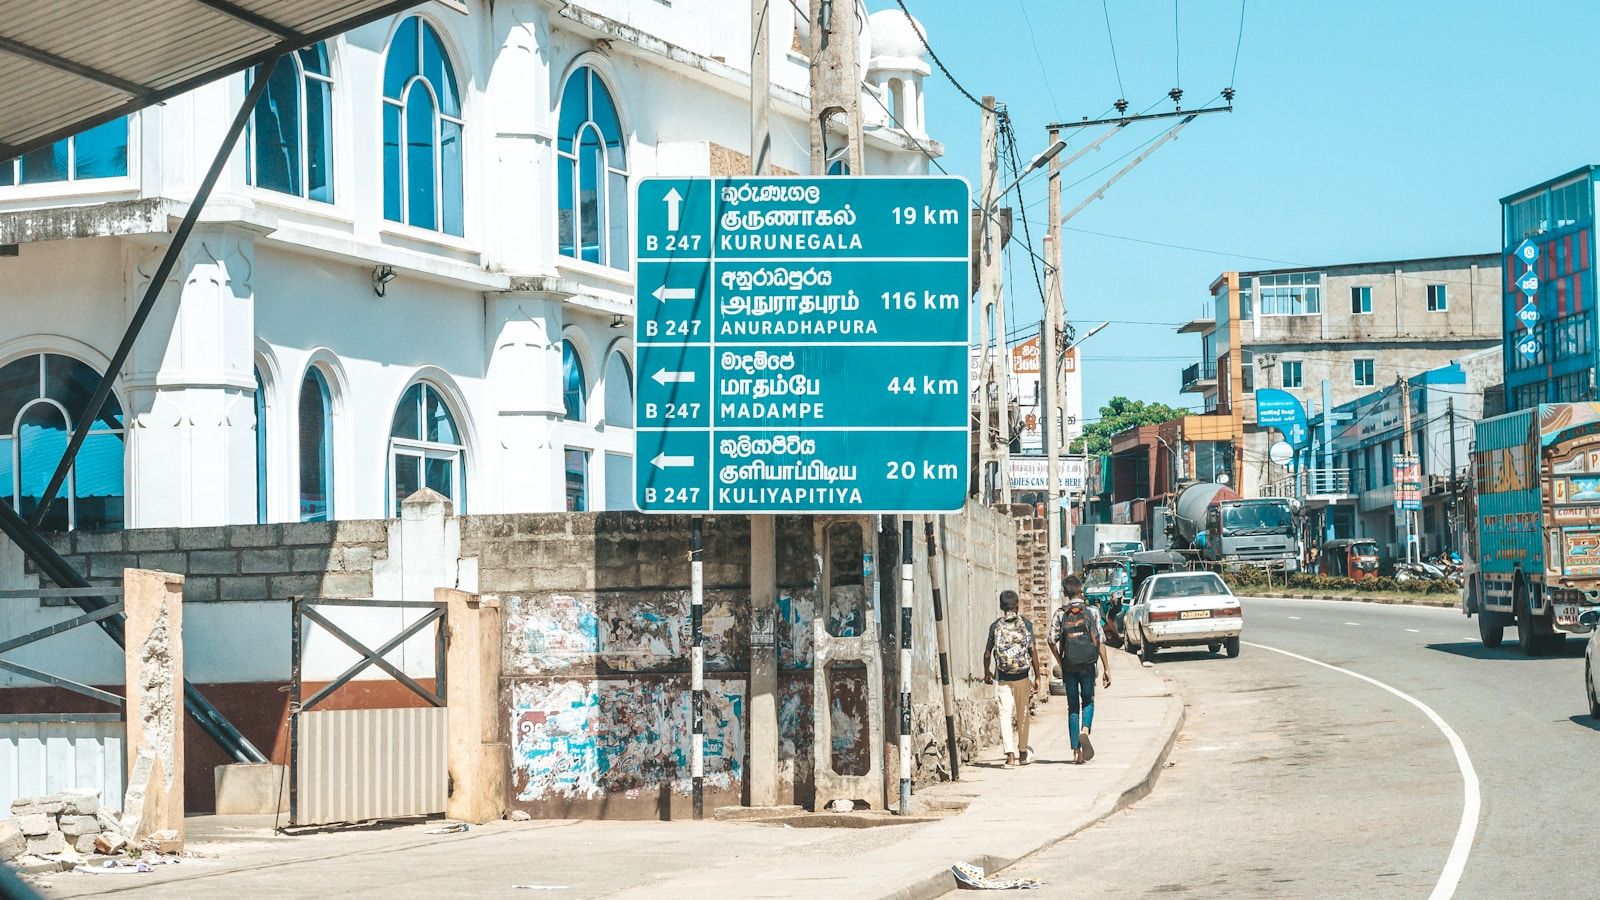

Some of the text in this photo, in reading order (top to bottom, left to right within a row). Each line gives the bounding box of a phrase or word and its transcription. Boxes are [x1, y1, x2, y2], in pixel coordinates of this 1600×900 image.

[720, 182, 821, 206] කුරුණෑගල
[720, 203, 857, 231] குருணாகல்
[892, 205, 959, 225] 19 km
[646, 234, 702, 251] B 247
[720, 233, 863, 251] KURUNEGALA
[720, 266, 833, 291] අනුරාධපුරය
[720, 289, 861, 316] அநுராதபுரம்
[881, 290, 959, 310] 116 km
[646, 320, 702, 337] B 247
[720, 319, 878, 335] ANURADHAPURA
[720, 350, 796, 375] මාදම්පේ
[720, 373, 821, 400] மாதம்பே
[887, 375, 959, 395] 44 km
[645, 402, 701, 419] B 247
[720, 402, 824, 419] MADAMPE
[719, 434, 817, 459] කුලියාපිටිය
[719, 459, 857, 484] குளியாப்பிடிய
[886, 460, 958, 480] 20 km
[1010, 477, 1030, 486] ADIES
[1031, 477, 1045, 486] CAN
[1064, 477, 1081, 487] HERE
[645, 487, 700, 503] B 247
[719, 487, 863, 504] KULIYAPITIYA
[1563, 607, 1576, 615] 40
